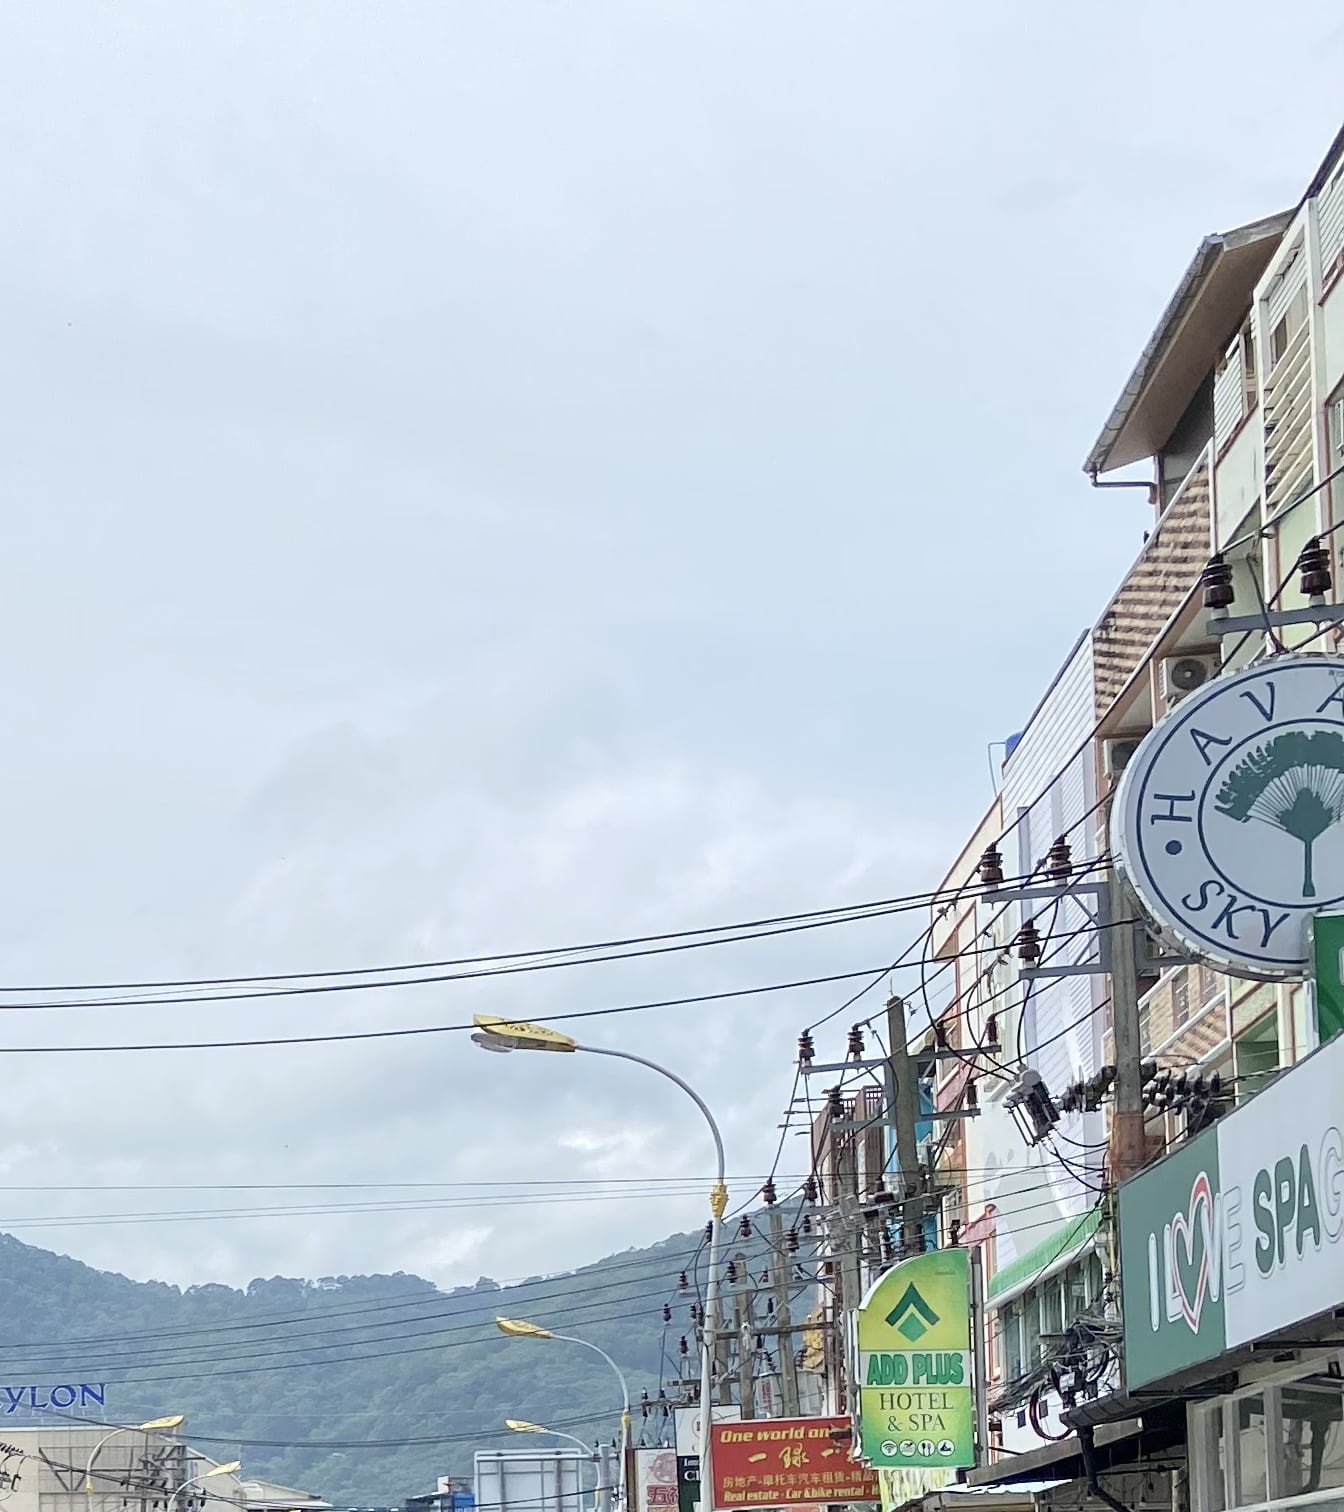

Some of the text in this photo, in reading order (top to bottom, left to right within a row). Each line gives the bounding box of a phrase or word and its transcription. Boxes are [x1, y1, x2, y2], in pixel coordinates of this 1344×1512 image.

[1182, 879, 1290, 948] SKY
[867, 1352, 965, 1386] ADD PLUS
[879, 1392, 955, 1411] HOTEL
[887, 1413, 947, 1432] & SPA
[720, 1426, 830, 1444] One world on
[724, 1490, 746, 1502] Real
[746, 1489, 780, 1501] estate
[786, 1488, 803, 1500] Car
[833, 1486, 865, 1499] rental
